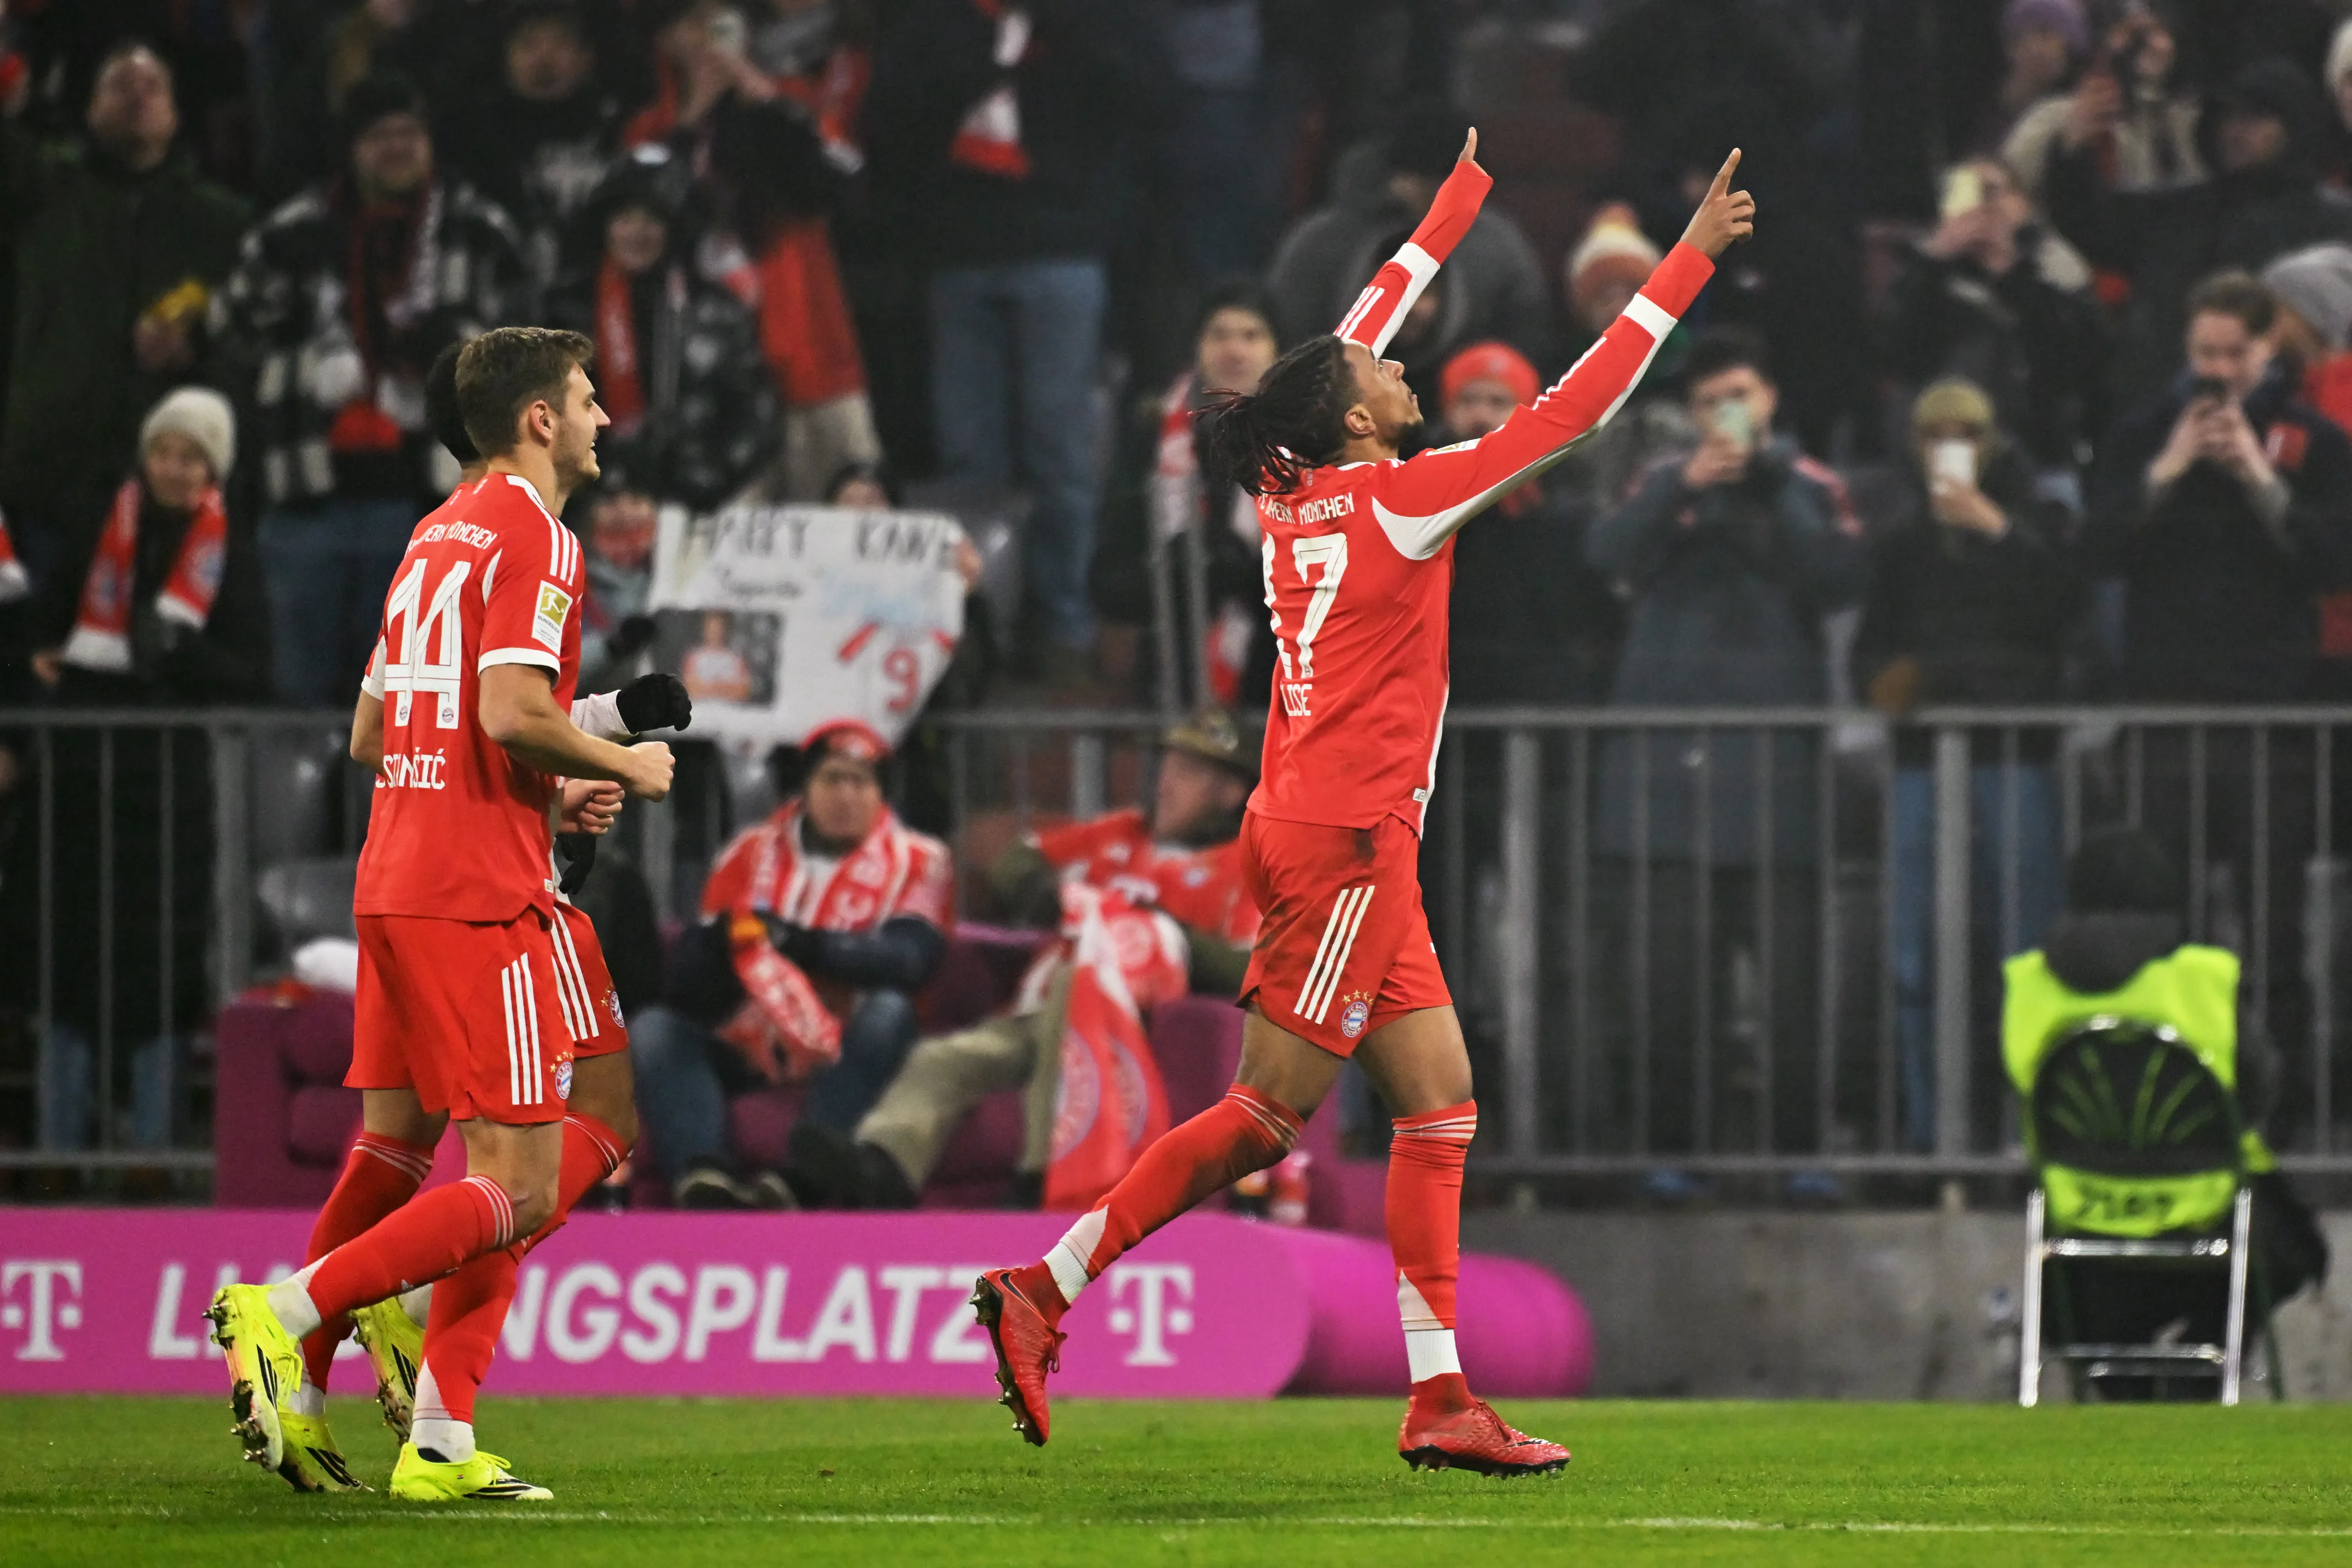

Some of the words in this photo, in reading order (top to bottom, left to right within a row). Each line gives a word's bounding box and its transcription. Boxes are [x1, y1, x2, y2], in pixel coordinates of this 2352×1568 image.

[385, 557, 472, 729] 44
[1262, 531, 1348, 680] 17
[882, 647, 920, 714] 9
